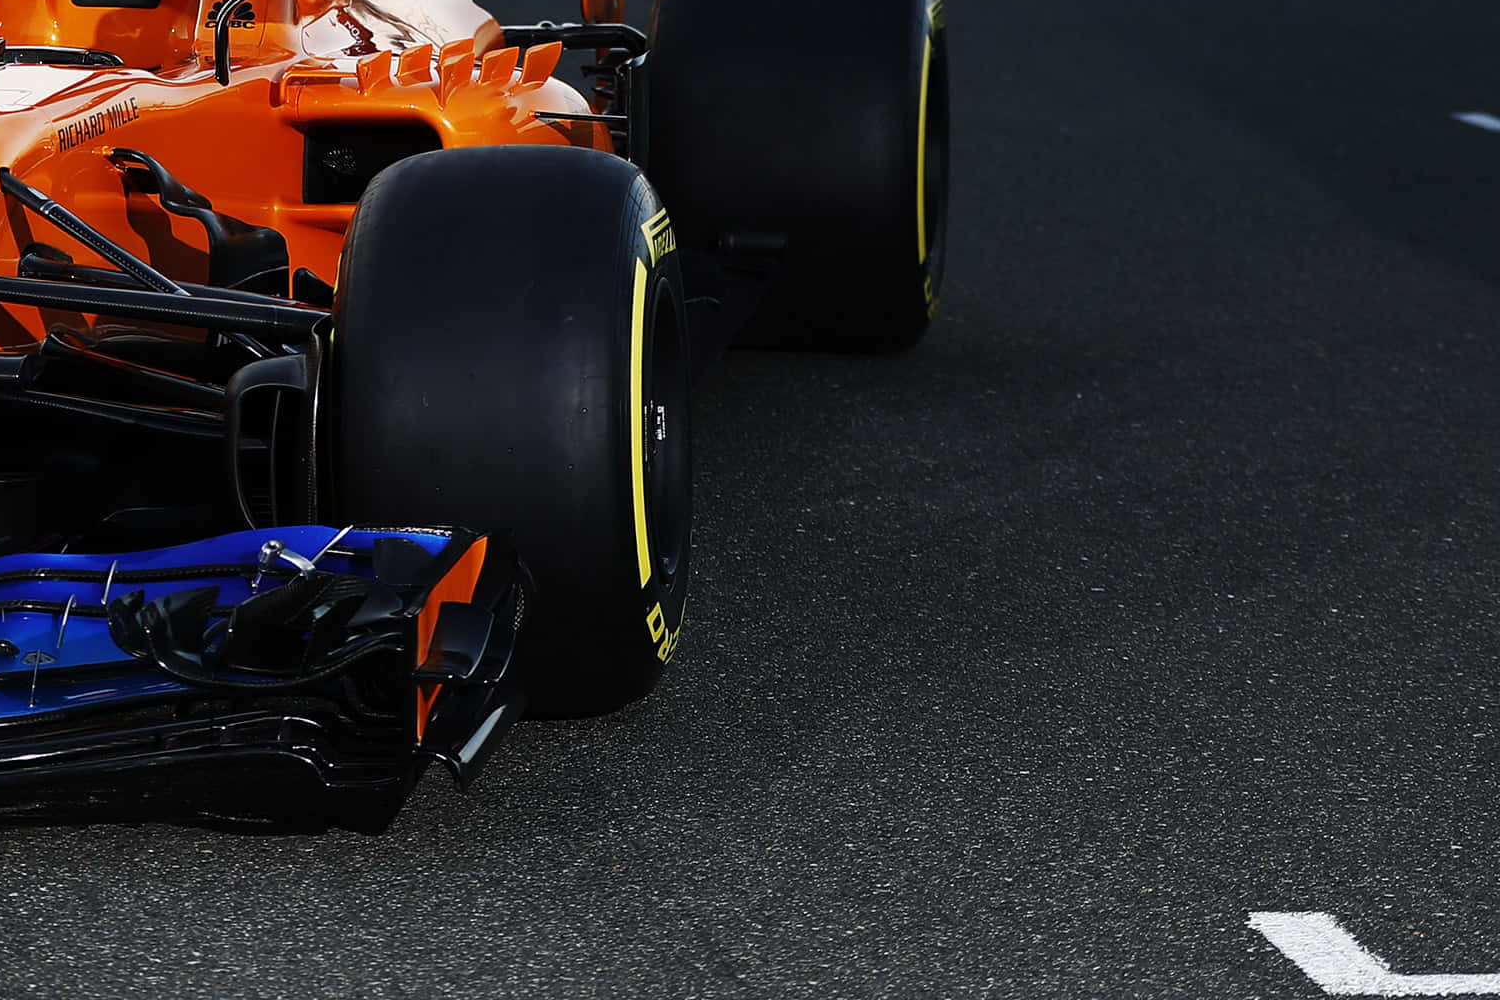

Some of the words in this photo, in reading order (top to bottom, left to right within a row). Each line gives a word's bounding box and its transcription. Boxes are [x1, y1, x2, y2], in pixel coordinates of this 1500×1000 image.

[205, 20, 256, 30] CBC
[57, 111, 106, 153] RICHARD
[106, 97, 140, 131] MILLE
